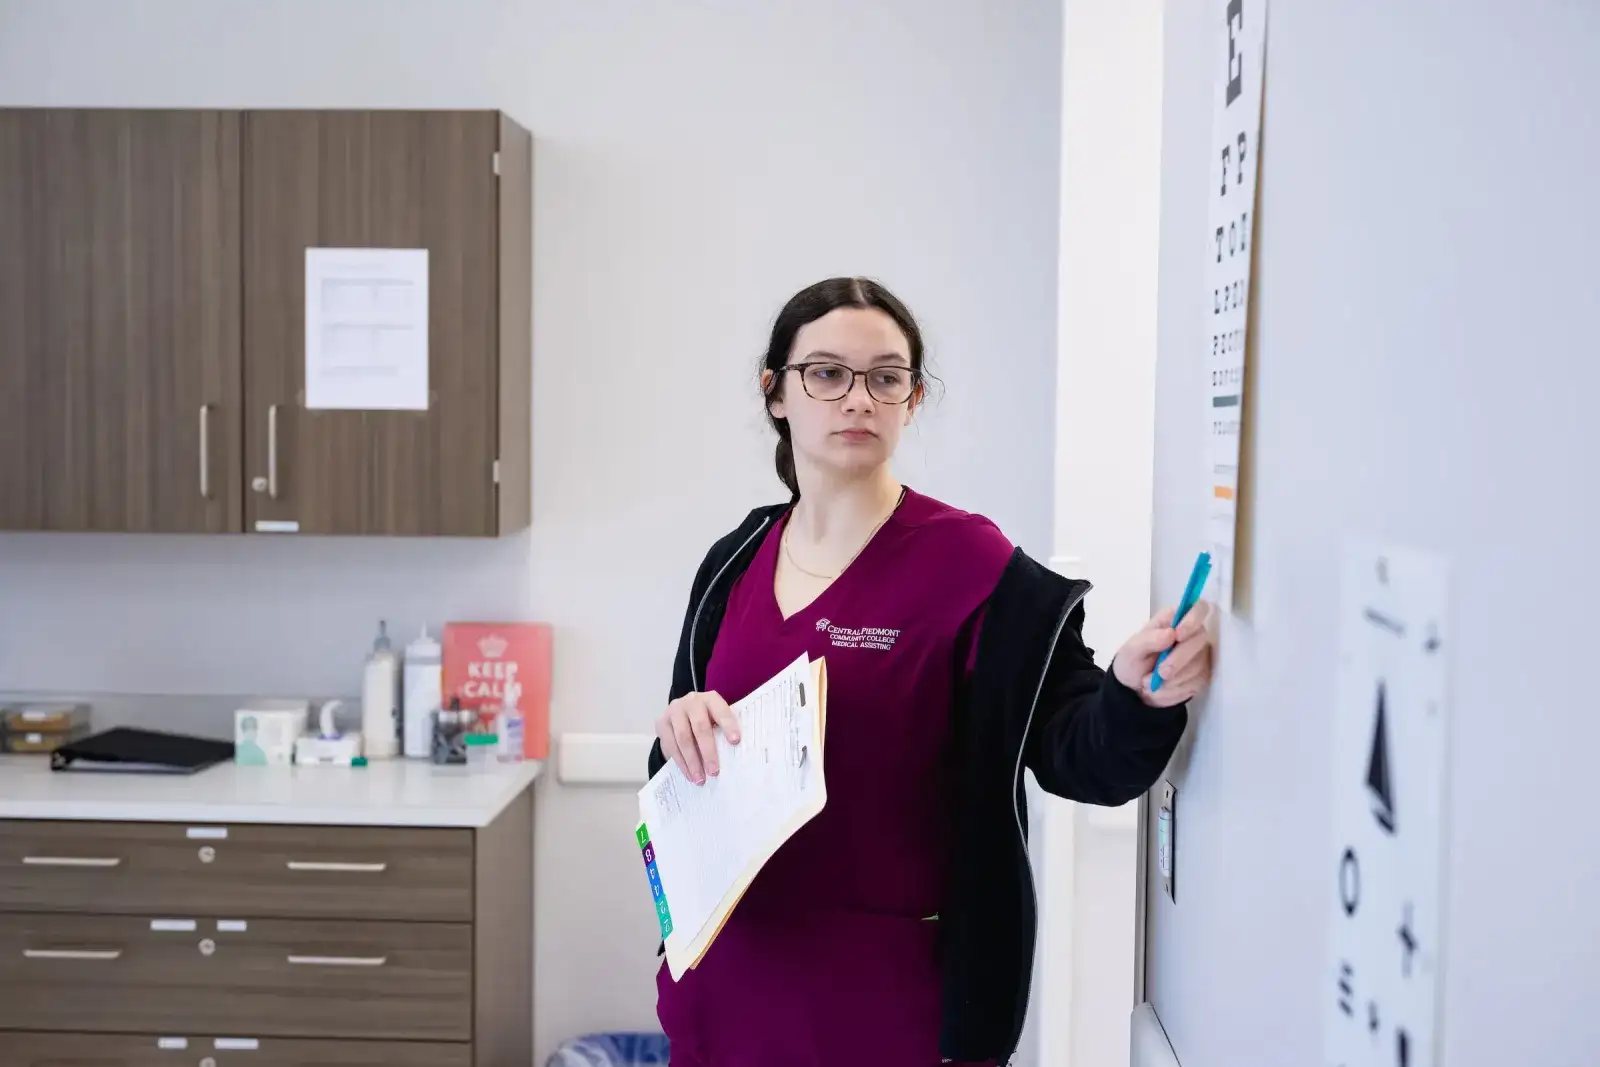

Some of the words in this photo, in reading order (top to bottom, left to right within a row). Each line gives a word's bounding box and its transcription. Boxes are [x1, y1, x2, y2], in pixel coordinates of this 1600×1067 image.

[1226, 0, 1242, 107] E
[861, 627, 901, 637] PIEDMONT
[830, 633, 867, 642] COMMUNITY
[866, 635, 896, 644] COLLEGE
[831, 640, 859, 648] MEDICAL
[860, 642, 892, 651] ASSISTING
[468, 661, 518, 680] KEEP
